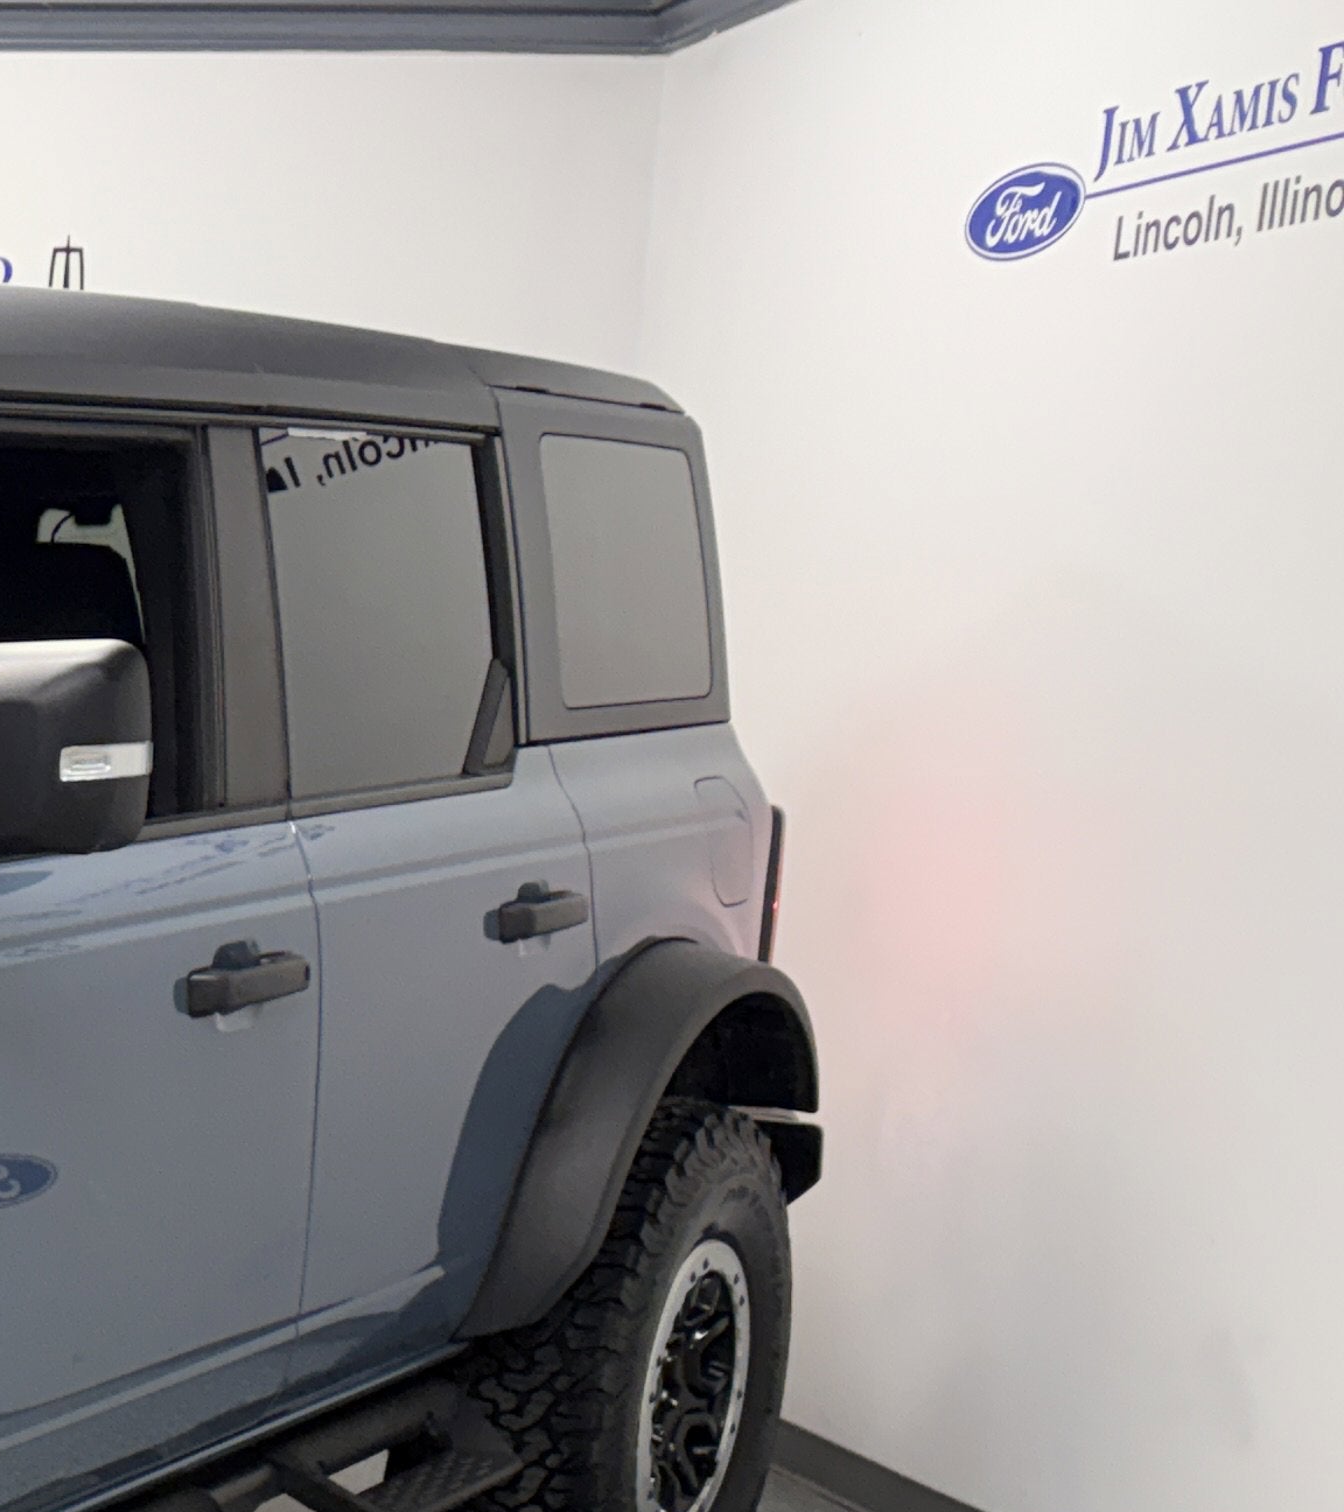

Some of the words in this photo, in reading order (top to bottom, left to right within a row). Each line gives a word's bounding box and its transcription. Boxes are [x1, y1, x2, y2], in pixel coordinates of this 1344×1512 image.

[1094, 106, 1160, 183] JIM
[1166, 72, 1299, 152] XAMIS
[985, 182, 1062, 248] Ford
[1113, 195, 1243, 262] Lincoln,
[1256, 175, 1344, 234] Illino
